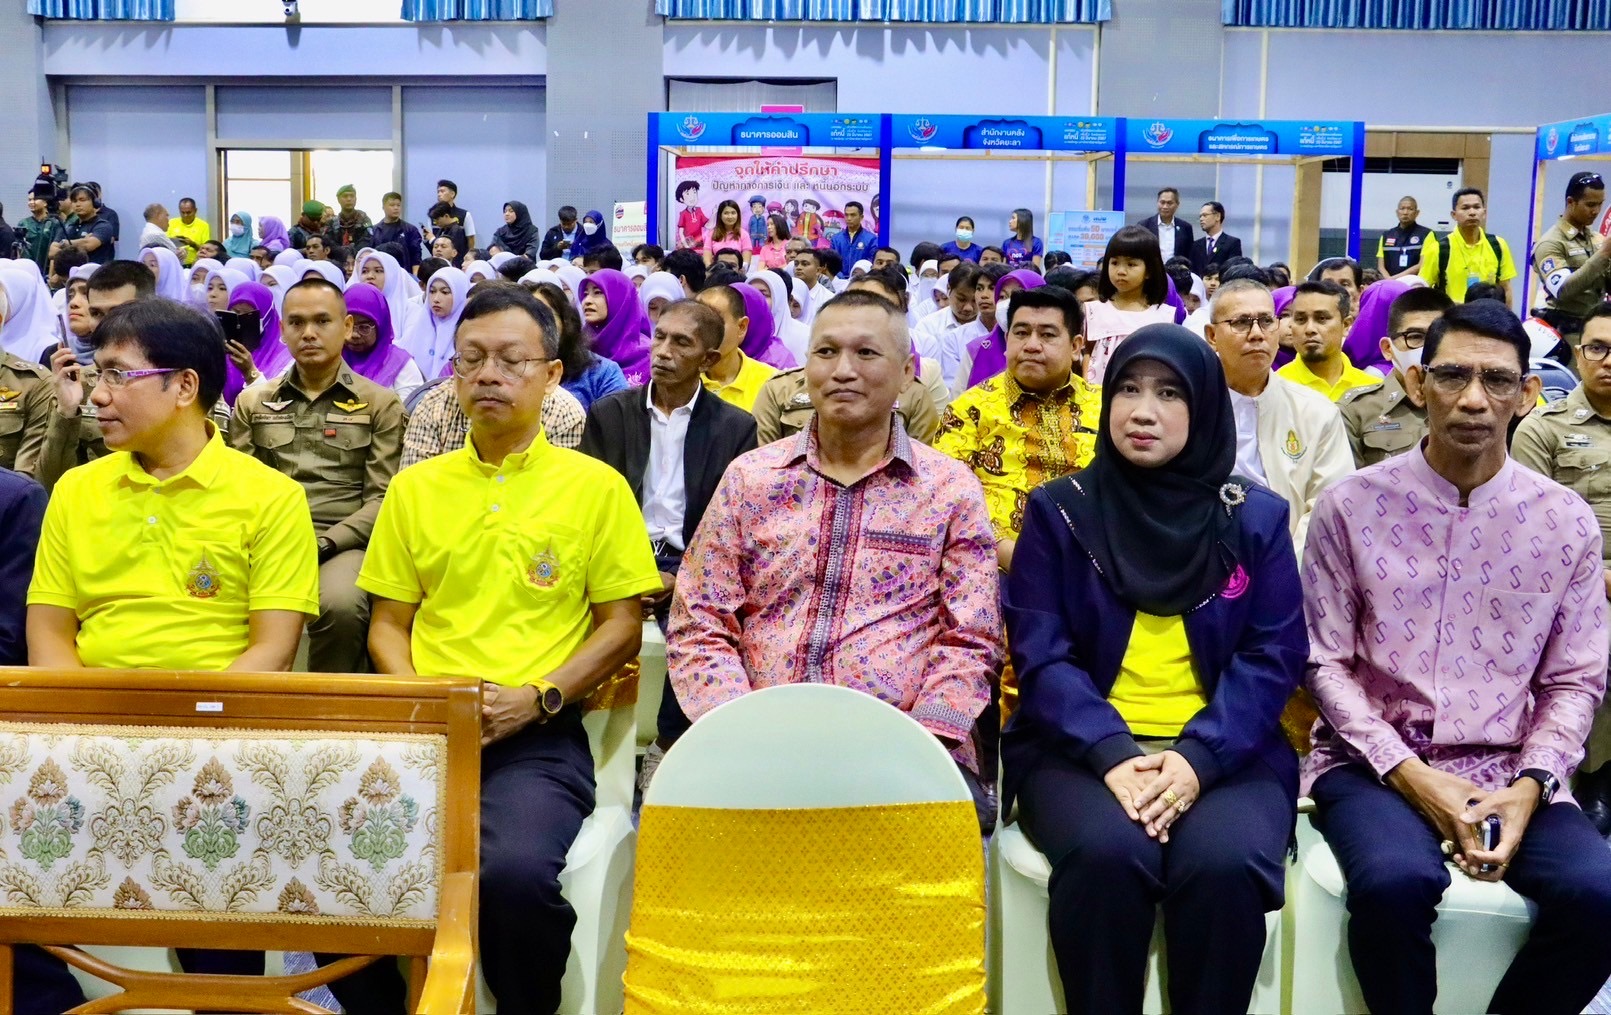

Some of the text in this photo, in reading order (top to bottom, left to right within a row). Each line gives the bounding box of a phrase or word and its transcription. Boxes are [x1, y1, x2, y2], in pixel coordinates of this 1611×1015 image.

[740, 129, 799, 139] ธนาคารออมสิน
[981, 127, 1025, 137] สำนักงานคลัง
[982, 137, 1022, 146] จังหวัดยะลา
[734, 160, 838, 179] จุดให้คำปรึกษา
[793, 182, 809, 191] และ
